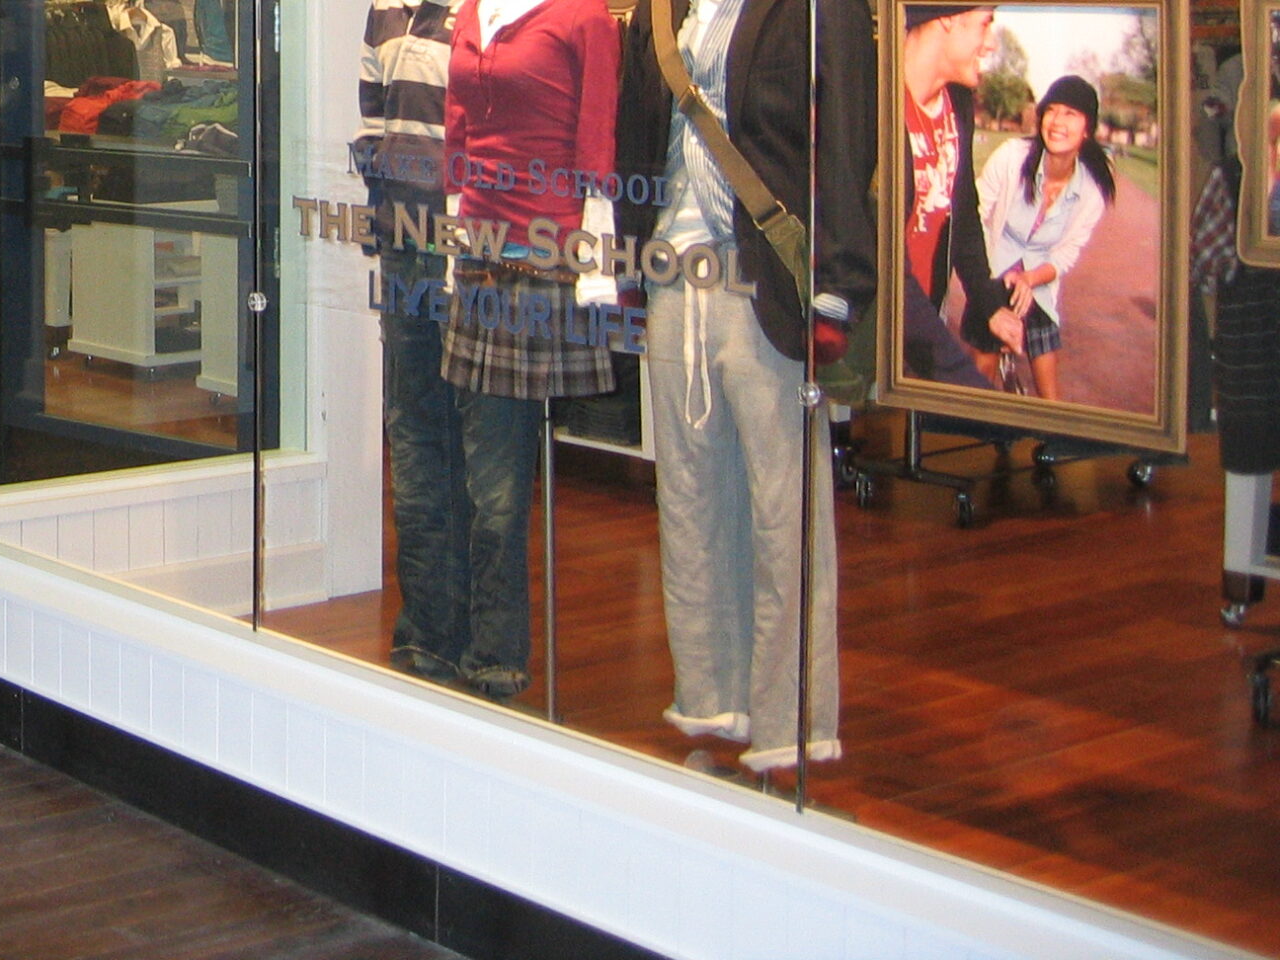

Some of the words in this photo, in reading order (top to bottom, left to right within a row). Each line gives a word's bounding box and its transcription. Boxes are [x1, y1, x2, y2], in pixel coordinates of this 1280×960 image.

[347, 141, 438, 184] MAKE
[447, 152, 517, 193] OLD
[527, 158, 672, 208] SCHOOL
[292, 195, 377, 245] THE
[393, 203, 509, 264] NEW
[528, 218, 757, 299] SCHOOL
[369, 270, 450, 323] LIVE
[460, 285, 552, 340] YOUR
[565, 301, 648, 354] LIFE
